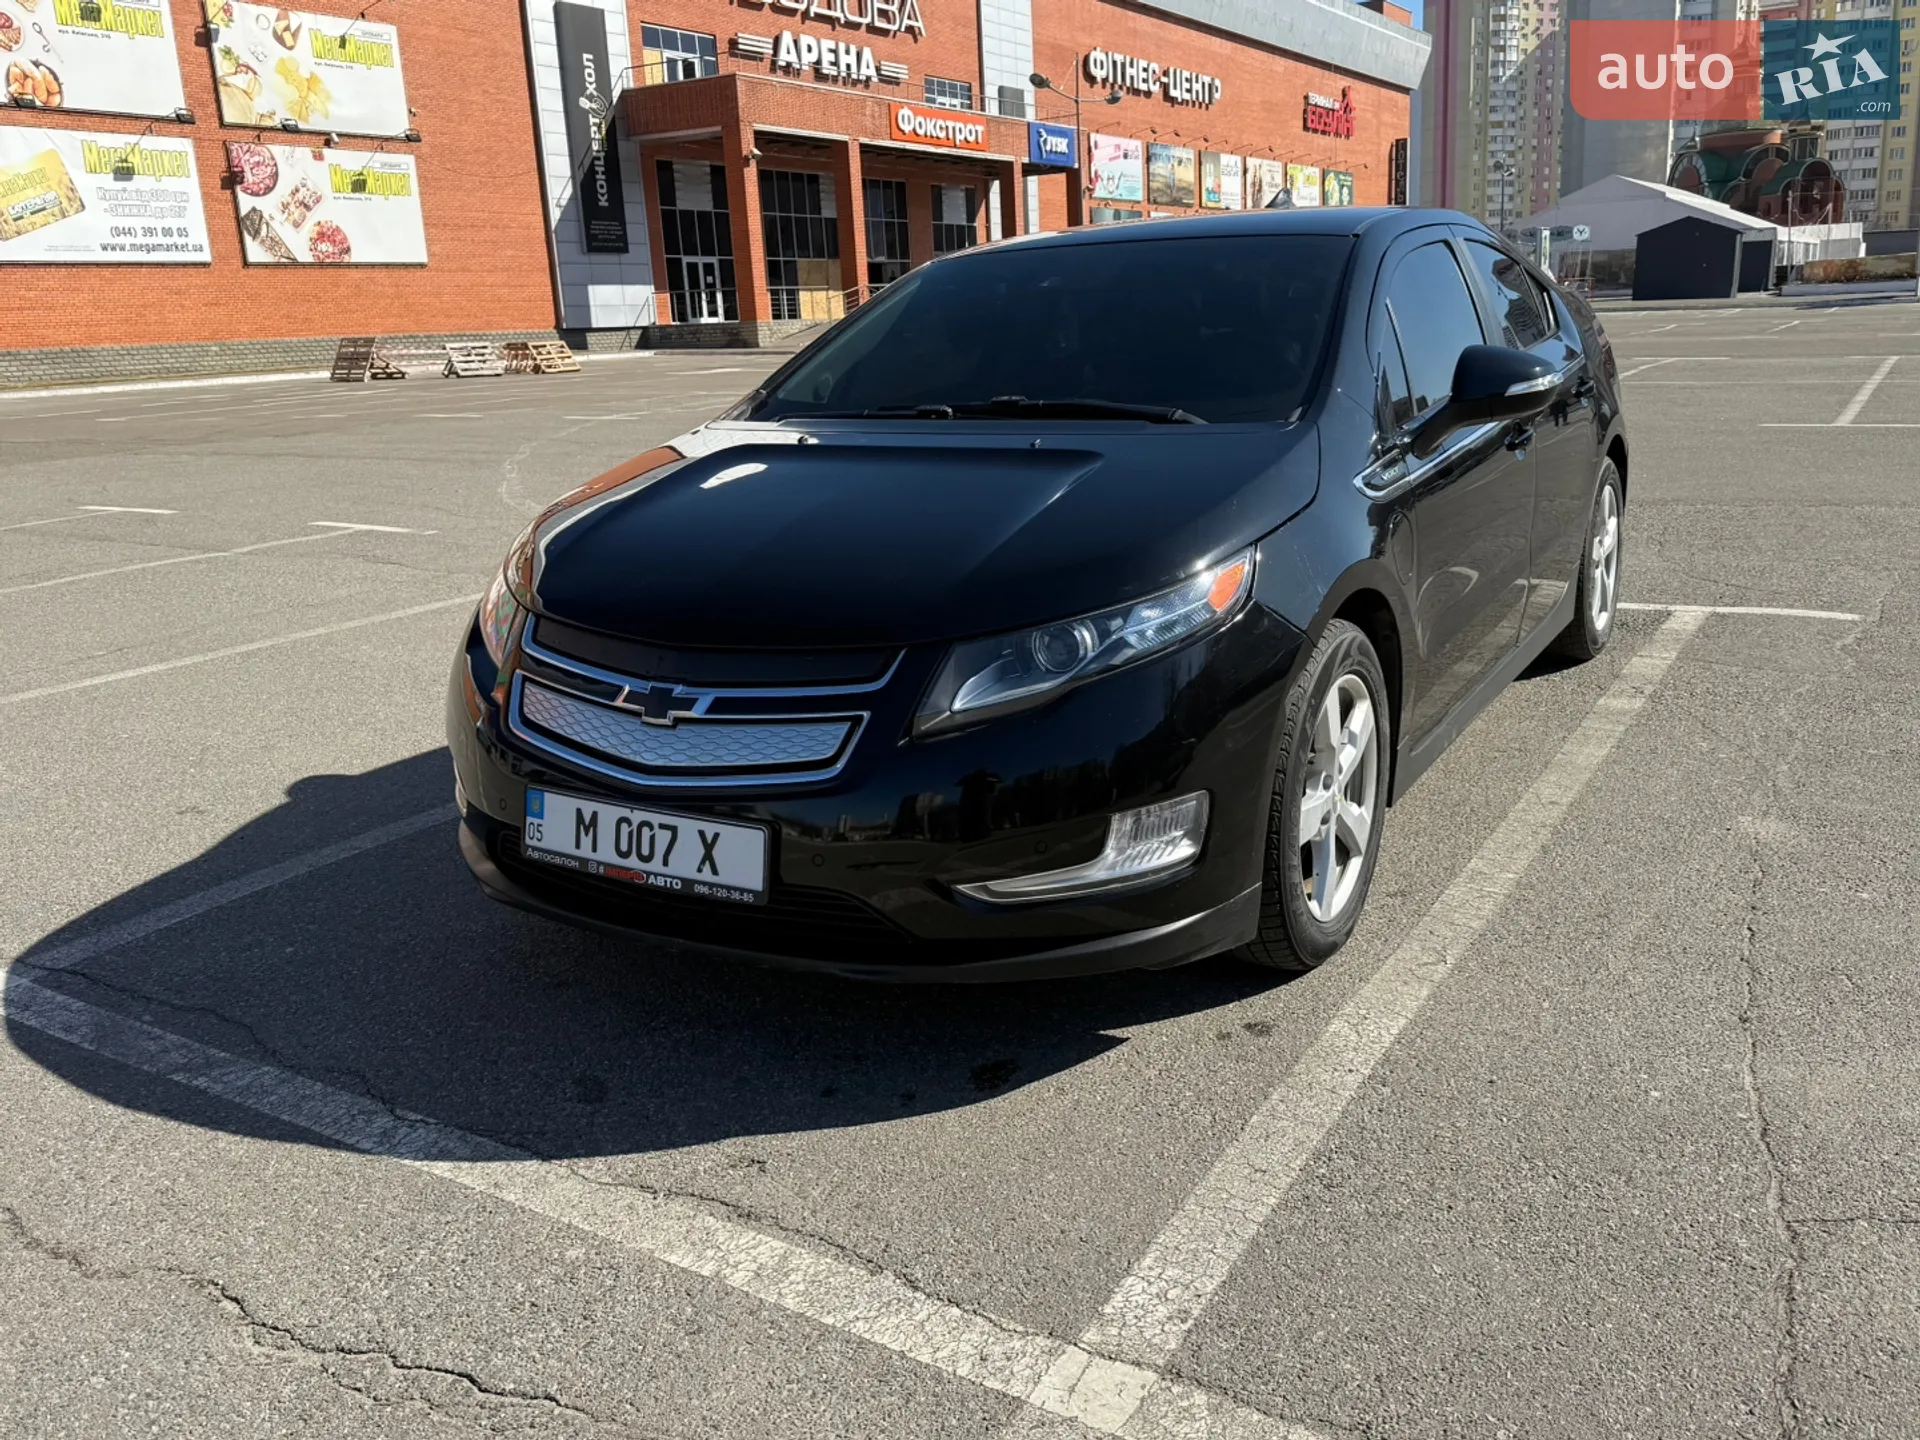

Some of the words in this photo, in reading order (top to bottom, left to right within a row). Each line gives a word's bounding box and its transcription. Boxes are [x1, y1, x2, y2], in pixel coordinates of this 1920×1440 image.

[778, 30, 879, 82] АРЕНА
[583, 53, 599, 97] ХОЛ
[1090, 46, 1222, 104] ФІТНЕС-ЦЕНТР
[896, 105, 985, 146] Фокстрот
[588, 113, 609, 207] КОНЦЕРТ
[1045, 136, 1069, 154] JYSK
[99, 242, 204, 254] www.megamarket.ua
[110, 226, 137, 239] (044)
[141, 226, 158, 238] 391
[162, 227, 174, 238] 00
[177, 227, 189, 238] 05
[527, 821, 543, 842] 05
[575, 807, 598, 853] M
[614, 816, 678, 867] 007
[696, 829, 720, 876] X
[526, 847, 579, 868] Автосалон
[648, 874, 682, 890] АВТО
